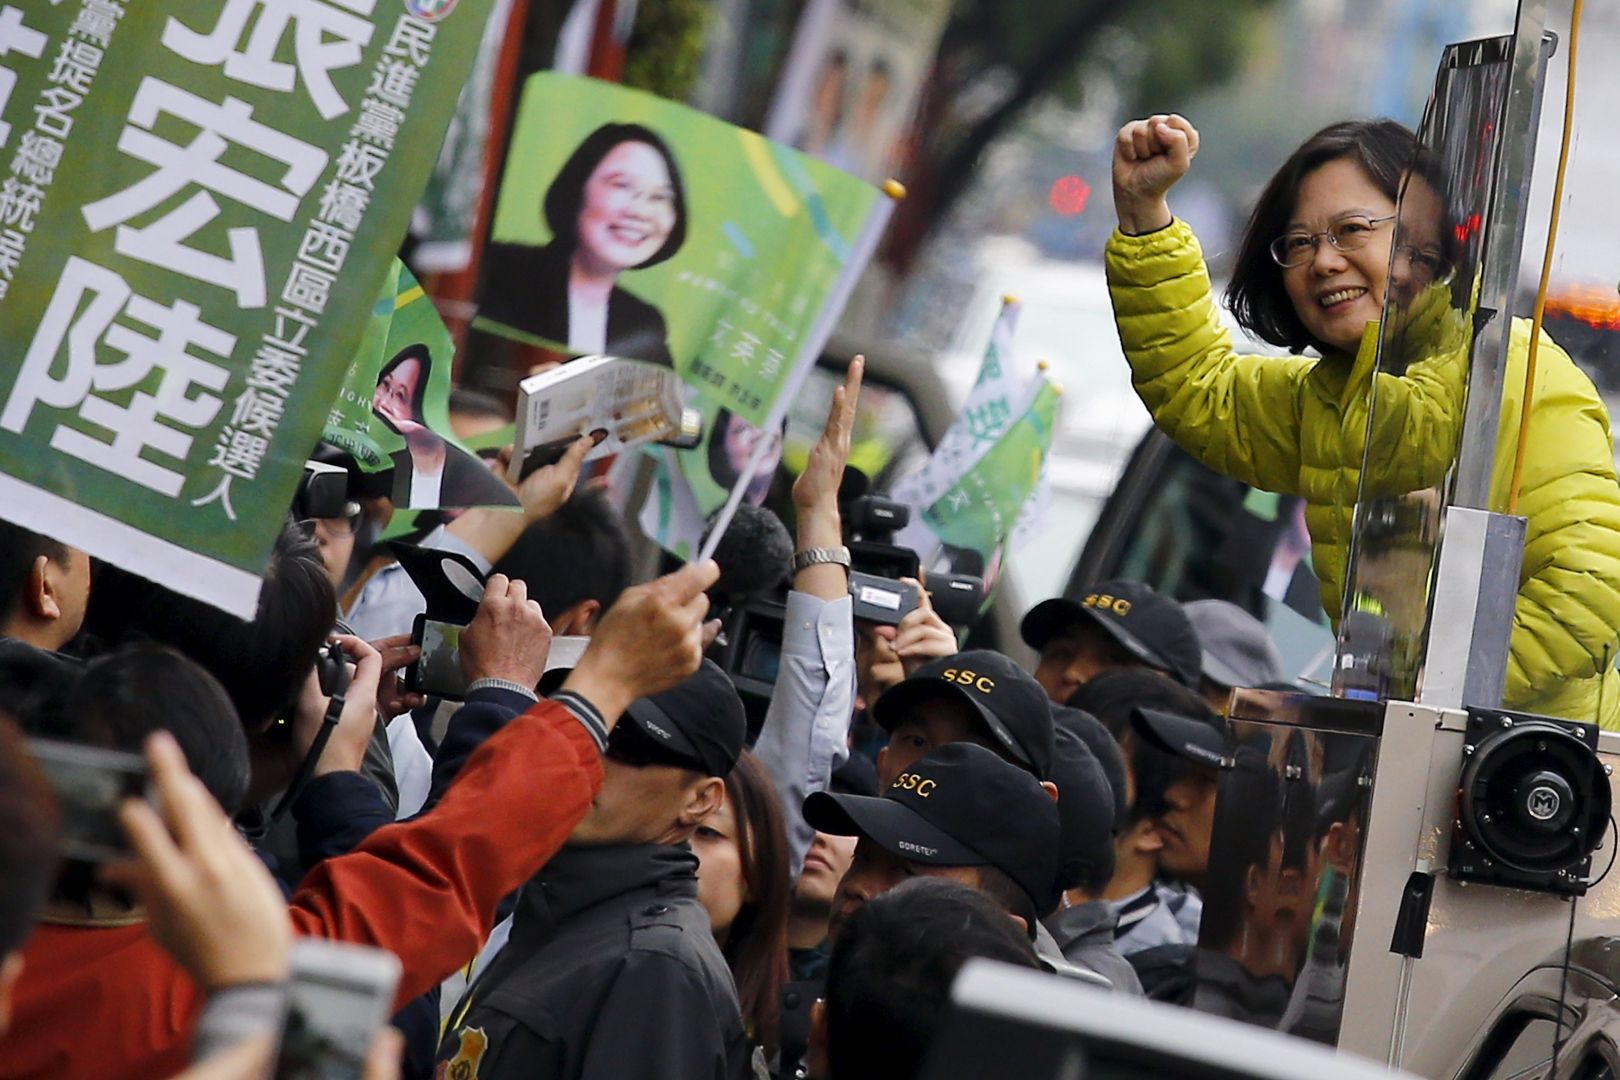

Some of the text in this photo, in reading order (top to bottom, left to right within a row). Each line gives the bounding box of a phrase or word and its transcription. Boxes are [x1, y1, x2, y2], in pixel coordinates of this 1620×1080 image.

[191, 14, 436, 521] 民進黨板橋西區立委候選人
[1082, 594, 1131, 616] SSC
[941, 668, 995, 693] SSC
[893, 773, 936, 797] SSC
